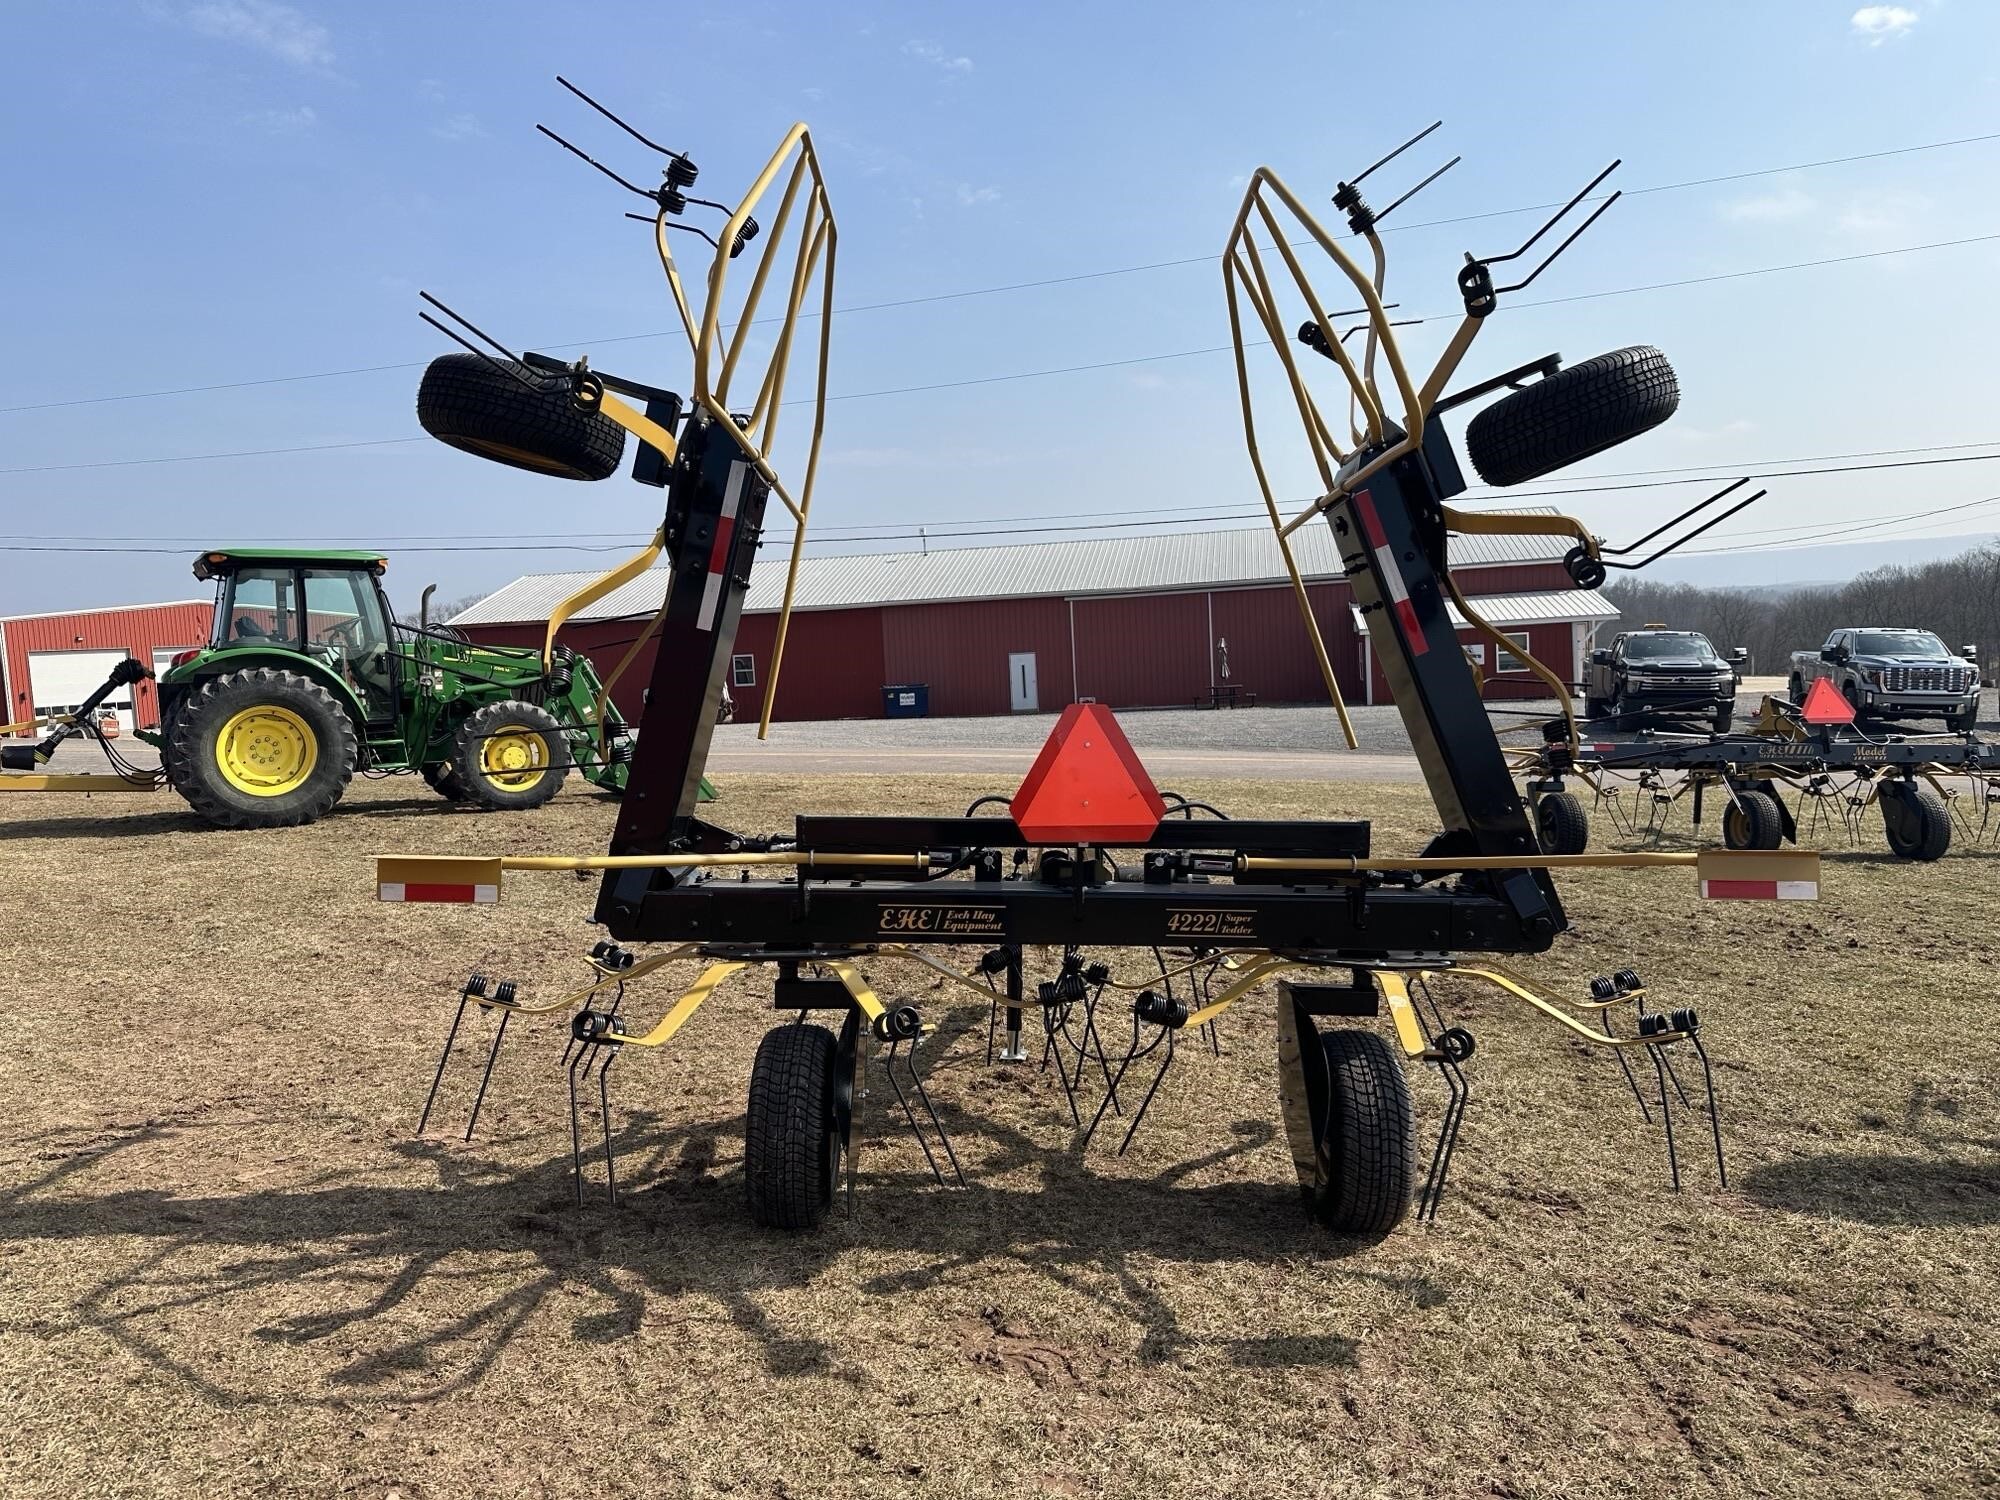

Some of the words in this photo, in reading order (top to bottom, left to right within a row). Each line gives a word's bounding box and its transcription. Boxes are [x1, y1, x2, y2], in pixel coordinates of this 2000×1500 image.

[1853, 746, 1887, 756] Model
[880, 909, 931, 930] EHE
[946, 910, 970, 920] Esch
[972, 910, 995, 922] Hay
[1167, 913, 1217, 931] 4222
[1224, 913, 1253, 925] Super
[943, 920, 1002, 932] Equipment
[1221, 925, 1253, 934] Tedder
